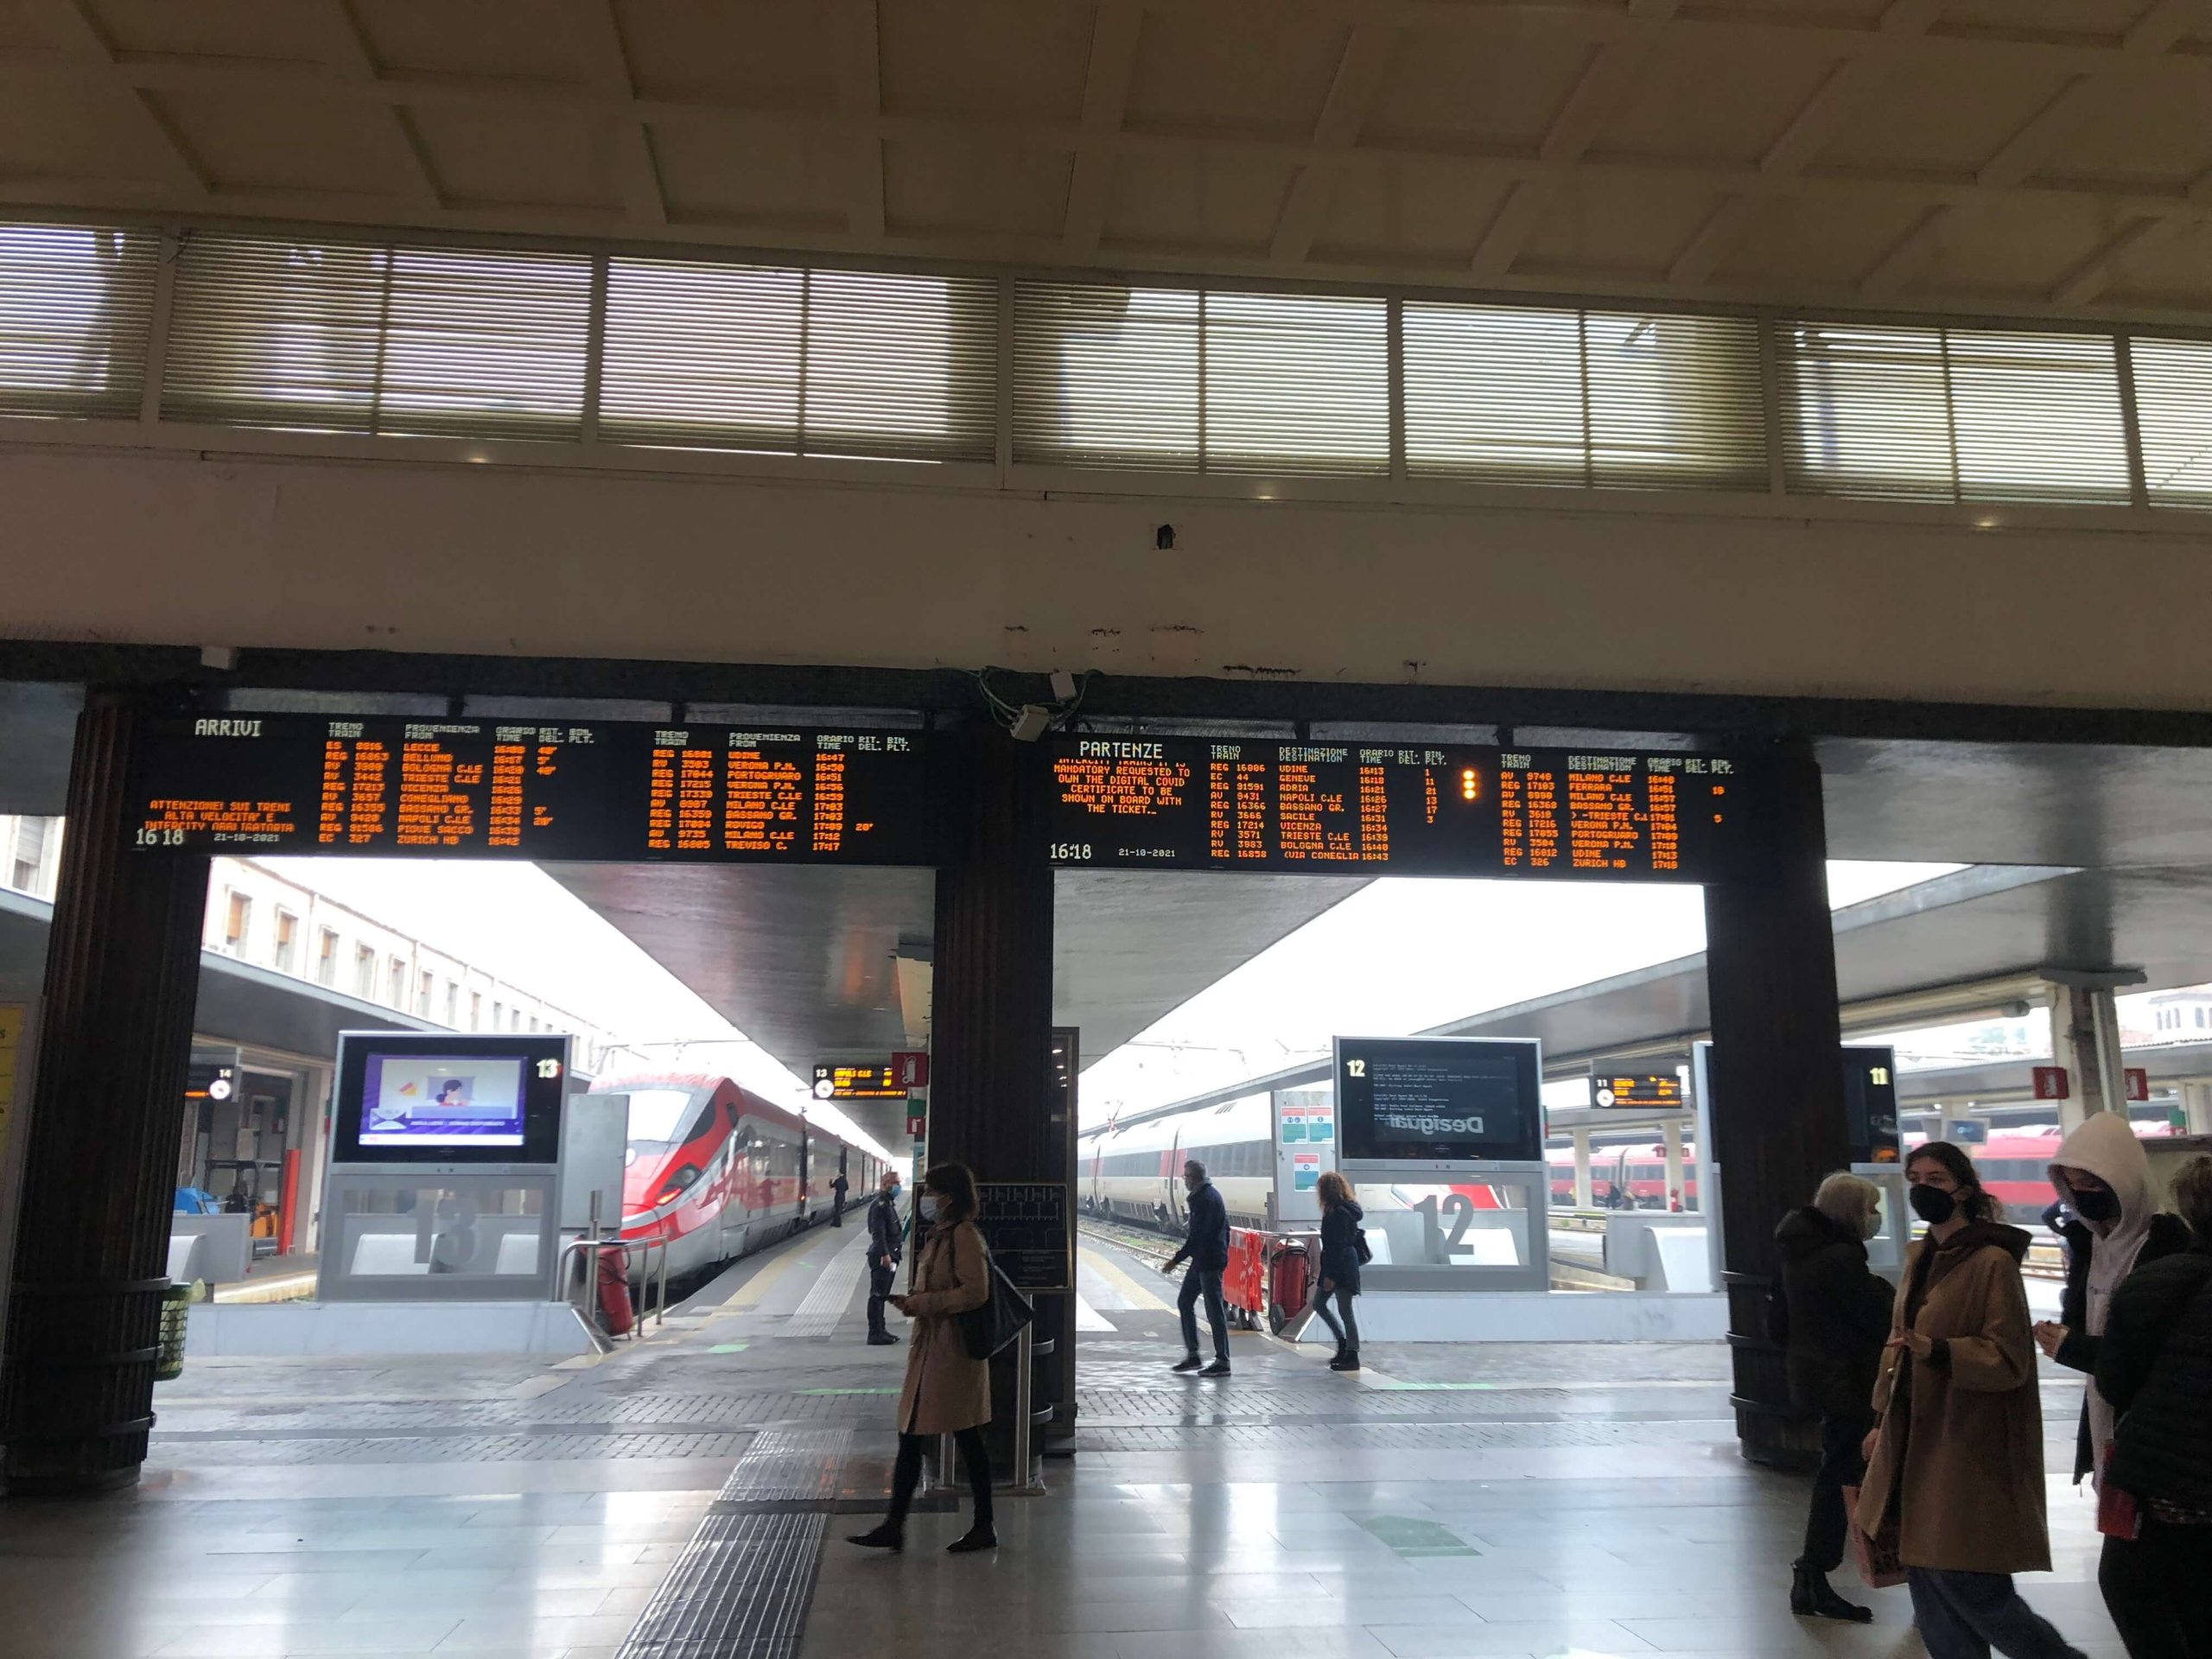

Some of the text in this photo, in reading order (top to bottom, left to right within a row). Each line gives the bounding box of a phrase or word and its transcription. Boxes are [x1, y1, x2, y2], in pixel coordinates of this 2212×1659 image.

[195, 719, 262, 737] ARRIVI
[729, 733, 800, 741] PROVENIENZA
[403, 743, 440, 752] LECCE
[1080, 741, 1163, 759] PARTENZE
[1279, 747, 1348, 756] DESTINAZIONE
[325, 752, 454, 762] REG BELLUNO
[1568, 756, 1637, 765] DESTINAZIONE
[401, 764, 453, 772] BOLOGNA
[1054, 765, 1190, 777] MANDATORY REQUESTED TO
[1279, 765, 1307, 773] UDINE
[1359, 766, 1384, 775] 16:13
[1425, 768, 1430, 777] 1
[402, 774, 449, 783] TRIESTE
[1058, 774, 1185, 787] OWN THE DIGITAL COVID
[1279, 774, 1316, 783] GENEVE
[1425, 778, 1434, 786] 11
[1500, 772, 1631, 783] AV MILANO C.LE
[1071, 785, 1173, 796] CERTIFICATE TO BE
[1210, 782, 1230, 791] REG
[1236, 783, 1264, 791] 91591
[1279, 784, 1309, 792] ADRIA
[1426, 787, 1437, 796] 21
[1500, 781, 1613, 792] REG FERRARA
[399, 794, 469, 804] CONEGLIANO
[727, 791, 772, 799] TRIESTE
[1062, 793, 1181, 805] SHOWN ON BOARD WITH
[1210, 791, 1224, 800] AV
[1236, 792, 1260, 801] 9431
[1280, 793, 1314, 802] NAPOLI
[1320, 794, 1342, 803] C.LE
[1426, 797, 1438, 805] 13
[1501, 791, 1632, 802] AV MILANO C.LE
[230, 802, 251, 811] SUI
[257, 802, 291, 812] TRENI
[321, 803, 450, 813] REG BASSANO
[1087, 804, 1105, 813] THE
[1211, 801, 1230, 810] REG
[1237, 802, 1266, 810] 16366
[1279, 803, 1323, 812] BASSANO
[1501, 800, 1613, 811] REG BASSANO
[165, 811, 194, 820] ALTA
[266, 813, 275, 822] E
[1237, 811, 1262, 820] 3666
[1280, 812, 1315, 821] SACILE
[319, 823, 343, 832] REG
[1237, 821, 1264, 830] 17214
[1280, 823, 1322, 831] VICENZA
[1529, 820, 1557, 829] 17216
[1570, 821, 1609, 830] VERONA
[214, 833, 280, 842] 21-10-2021
[1281, 832, 1321, 841] TRIESTE
[1571, 830, 1639, 840] PORTOGRUARO
[725, 841, 771, 849] TREVISO
[1280, 842, 1324, 850] BOLOGNA
[1329, 842, 1351, 851] C.LE
[1571, 840, 1610, 849] VERONA
[1050, 843, 1175, 859] 16:18 21-10-2021
[1211, 849, 1230, 858] REG
[1311, 852, 1359, 861] CONEGLIA
[1362, 853, 1389, 861] 16:43
[1572, 849, 1601, 858] UDINE
[1530, 858, 1549, 867] 326
[1573, 859, 1609, 868] ZURICH
[219, 1069, 232, 1077] 14
[536, 1058, 560, 1078] 13
[816, 1069, 827, 1077] 13
[1347, 1059, 1365, 1077] 12
[1870, 1067, 1889, 1084] 11
[1414, 1194, 1474, 1255] 12
[406, 1198, 476, 1265] 13
